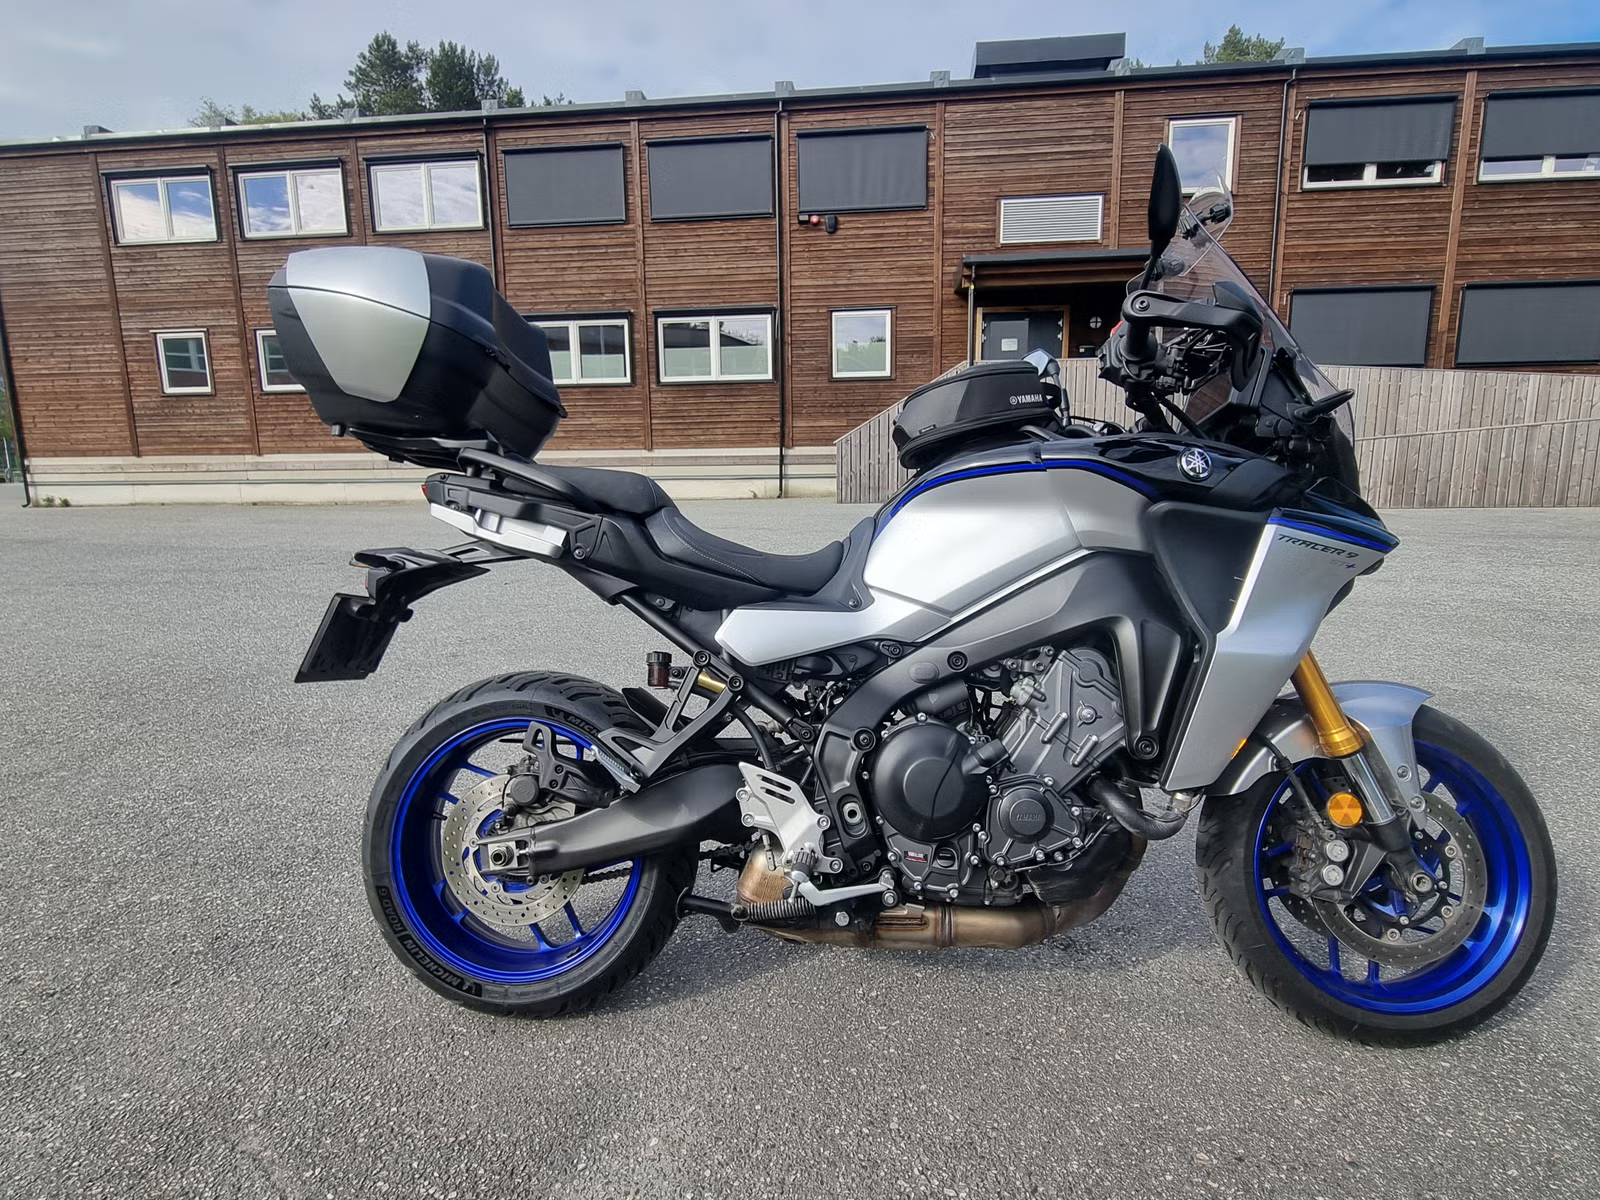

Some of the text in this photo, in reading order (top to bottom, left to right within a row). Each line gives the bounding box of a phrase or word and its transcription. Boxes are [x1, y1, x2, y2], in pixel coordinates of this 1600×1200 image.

[1017, 394, 1043, 404] YAMAHA
[1278, 533, 1359, 559] TRACER 9
[568, 715, 600, 737] MICH
[382, 900, 404, 931] ROAD
[403, 939, 462, 986] MICHELIN
